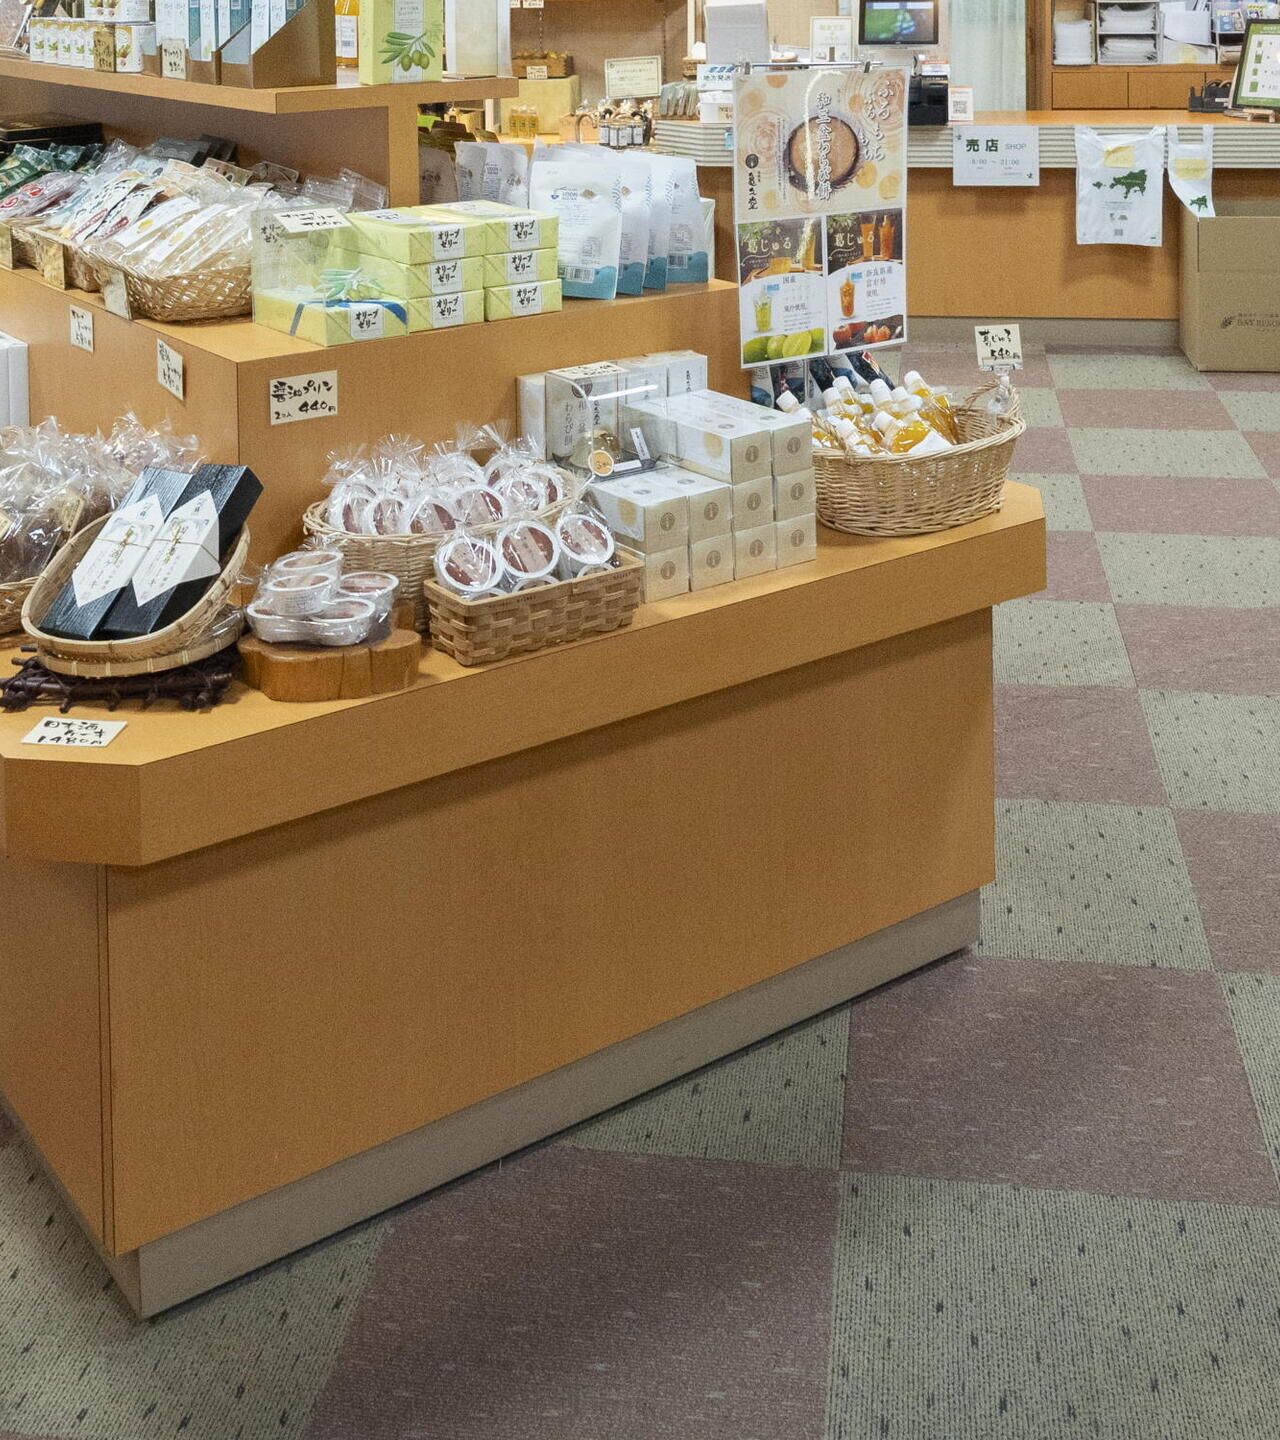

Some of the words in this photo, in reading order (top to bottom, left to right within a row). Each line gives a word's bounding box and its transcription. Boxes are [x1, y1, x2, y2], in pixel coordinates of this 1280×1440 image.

[966, 138, 999, 152] 売店
[513, 220, 535, 233] オリーブ
[437, 229, 460, 242] オリーブ
[516, 229, 533, 240] ゼリー
[440, 238, 459, 249] ゼリー
[511, 254, 534, 266] オリーブ
[435, 263, 458, 276] オリーブ
[515, 263, 532, 273] ゼリー
[438, 272, 457, 283] ゼリー
[516, 286, 538, 299] オリーブ
[436, 296, 459, 308] オリーブ
[519, 295, 536, 307] ゼリー
[355, 309, 378, 321] オリーブ
[439, 305, 457, 317] ゼリー
[358, 318, 377, 330] ゼリー
[272, 379, 334, 403] 醤油プリン
[298, 400, 336, 415] 440円
